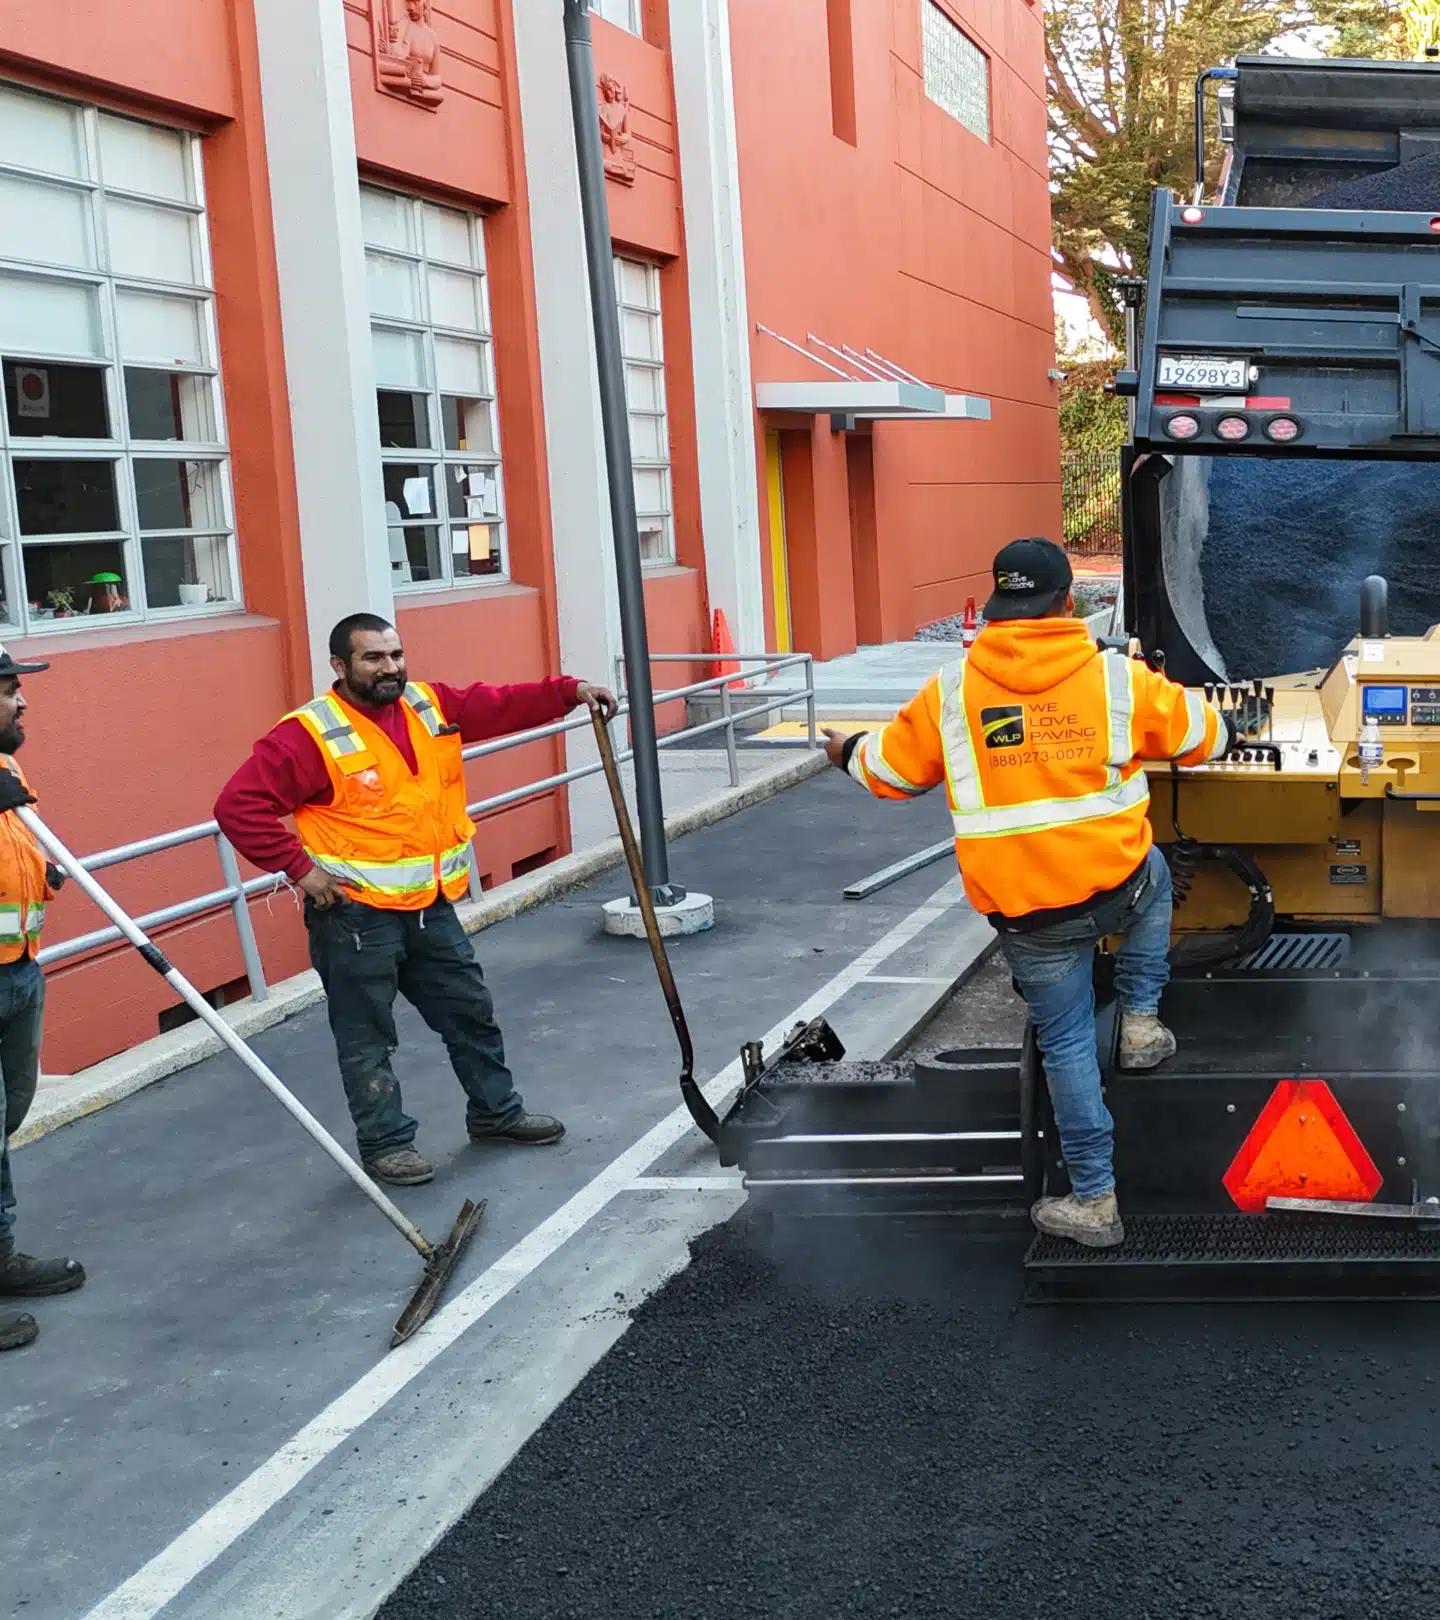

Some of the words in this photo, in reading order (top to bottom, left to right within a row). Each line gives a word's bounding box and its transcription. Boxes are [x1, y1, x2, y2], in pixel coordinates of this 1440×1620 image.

[1162, 367, 1240, 385] 19698Y3
[1028, 702, 1059, 712] WE
[1029, 714, 1079, 727] LOVE
[993, 733, 1021, 744] WLP
[1030, 727, 1096, 741] PAVING
[989, 746, 1095, 769] (888)273-0077
